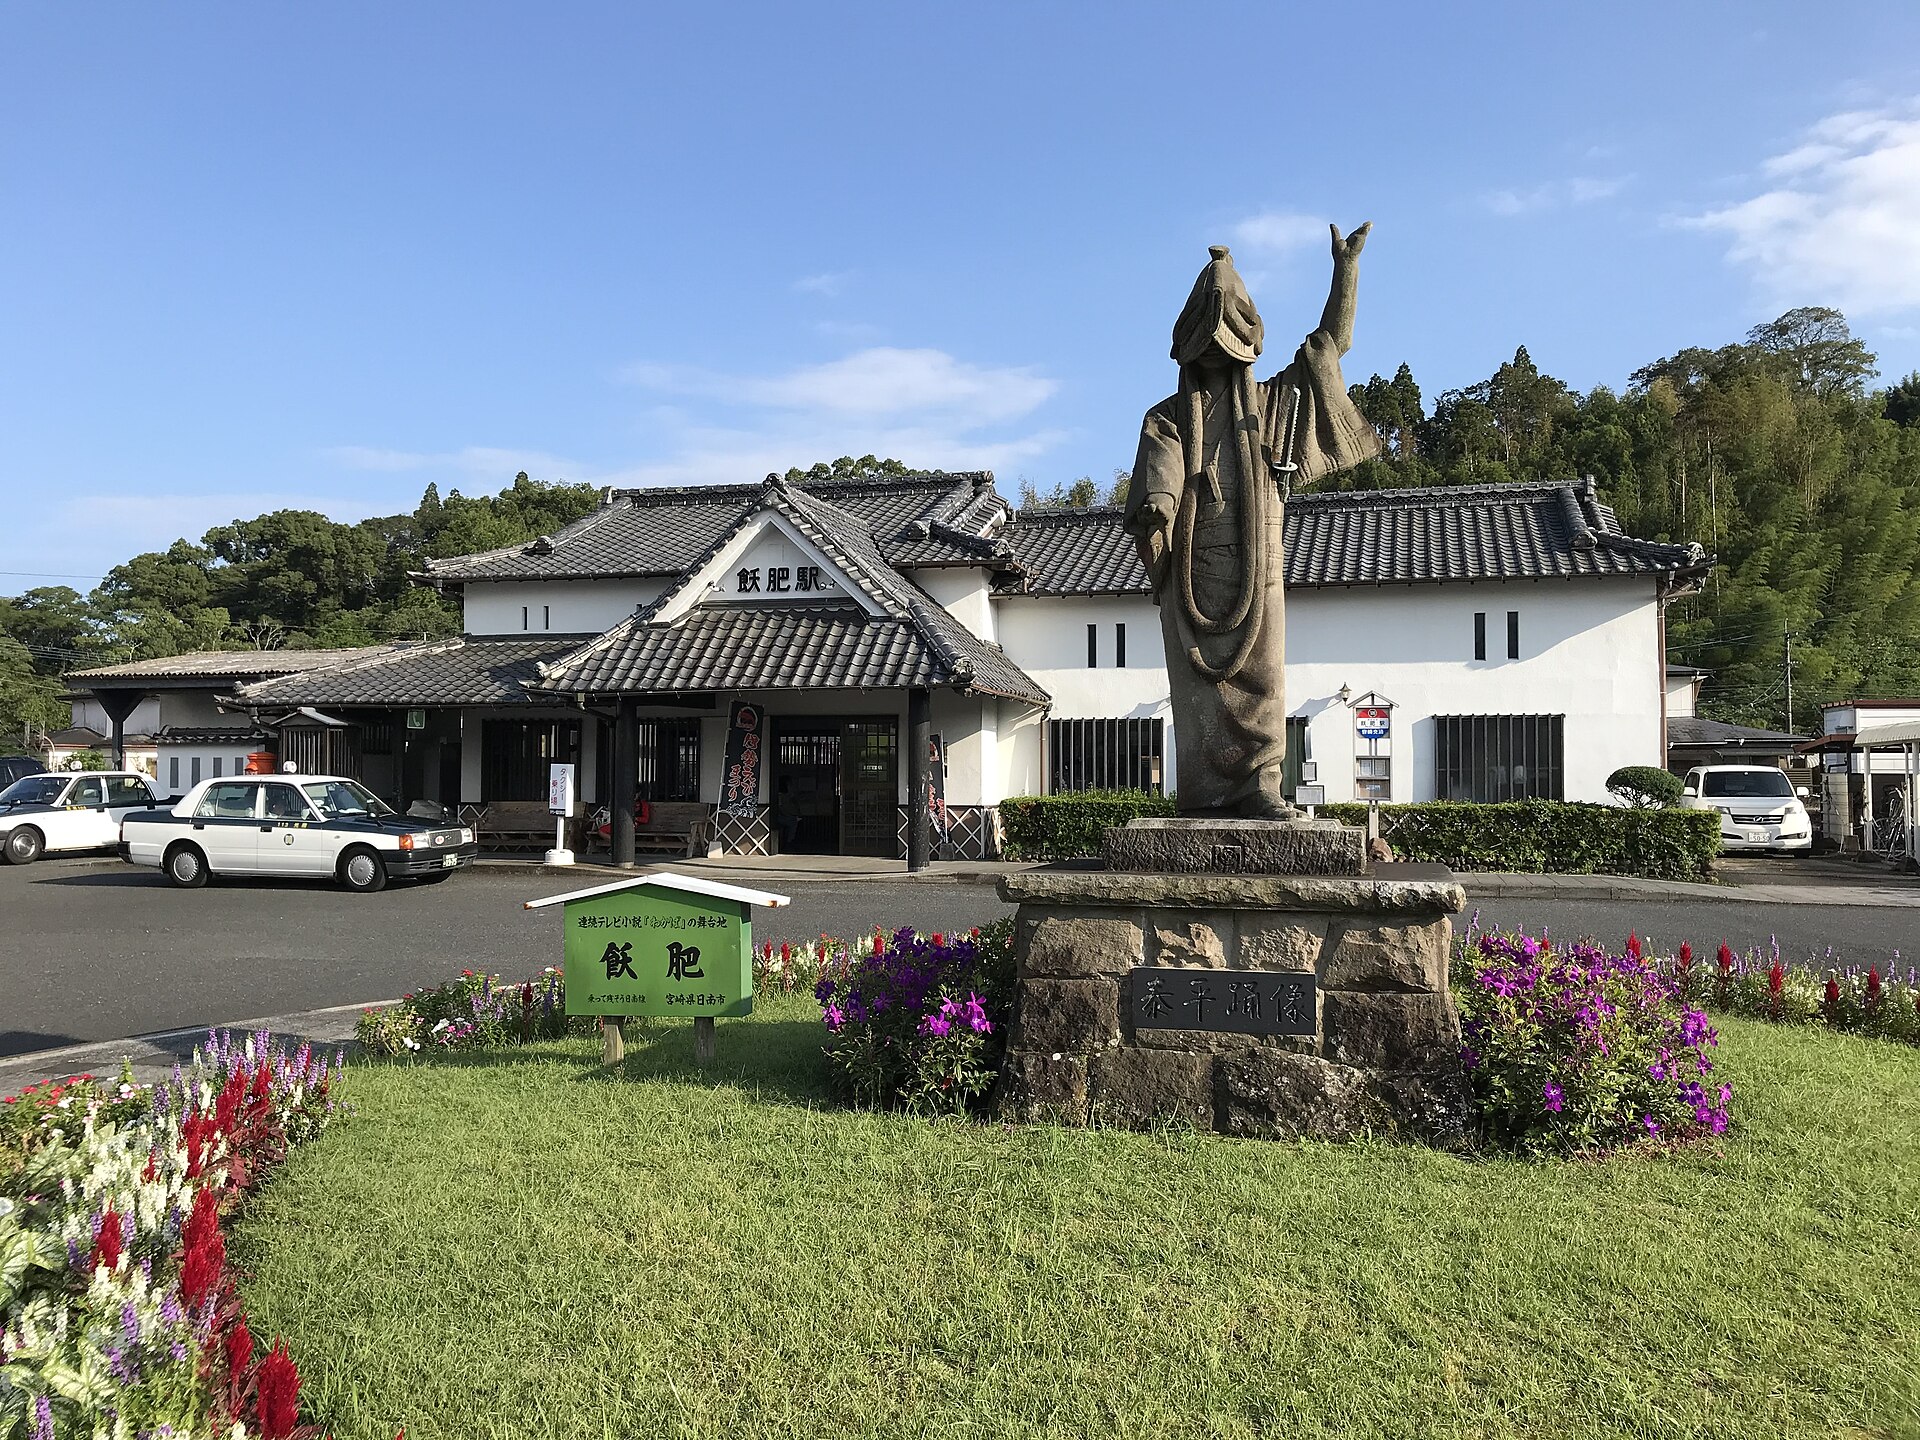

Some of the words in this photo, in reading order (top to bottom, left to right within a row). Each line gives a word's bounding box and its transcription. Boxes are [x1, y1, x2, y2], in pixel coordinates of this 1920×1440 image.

[737, 567, 820, 593] 飫肥駅
[559, 768, 567, 801] タクシー
[727, 764, 742, 802] まつり
[598, 941, 705, 981] 飫肥
[665, 993, 726, 1006] 宮崎県日南市
[1139, 976, 1312, 1025] 泰平踊像
